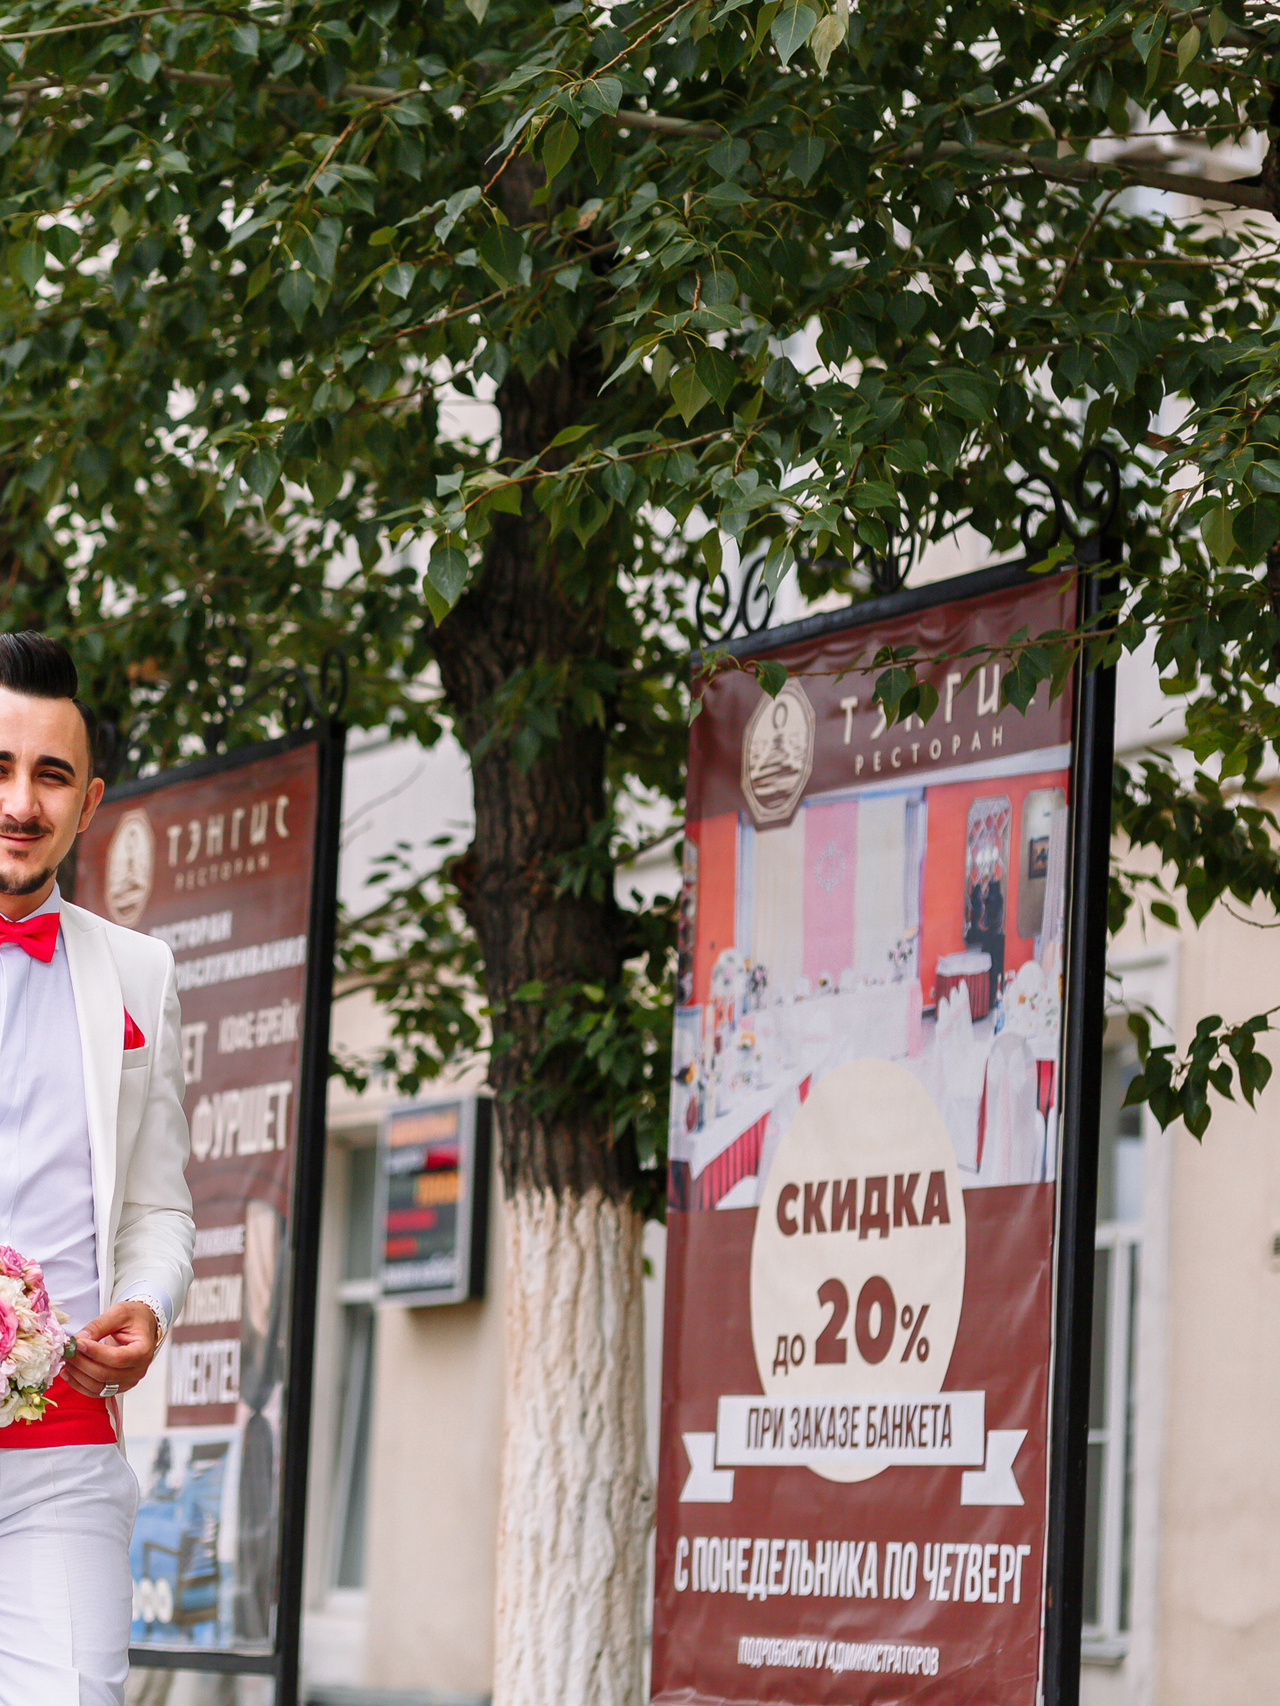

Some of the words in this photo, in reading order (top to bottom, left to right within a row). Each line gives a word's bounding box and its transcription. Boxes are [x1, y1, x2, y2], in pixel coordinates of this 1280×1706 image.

[855, 726, 1003, 775] РЕСТОРАН
[167, 795, 289, 867] ТЭНГИС
[191, 1080, 293, 1163] ФУРШЕТ
[777, 1170, 951, 1240] СКИДКА
[814, 1275, 931, 1365] 20%
[747, 1407, 784, 1449] ПРИ
[790, 1405, 860, 1448] ЗАКАЗЕ
[866, 1403, 952, 1448] БАНКЕТА
[674, 1536, 689, 1592] С
[691, 1536, 878, 1601] ПОНЕДЕЛЬНИКА
[883, 1541, 918, 1600] ПО
[923, 1542, 1031, 1604] ЧЕТВЕРГ
[738, 1636, 817, 1669] ПОДРОБНОСТИ
[816, 1640, 828, 1669] У
[825, 1641, 940, 1675] АДМИНИСТРАТОРОВ
